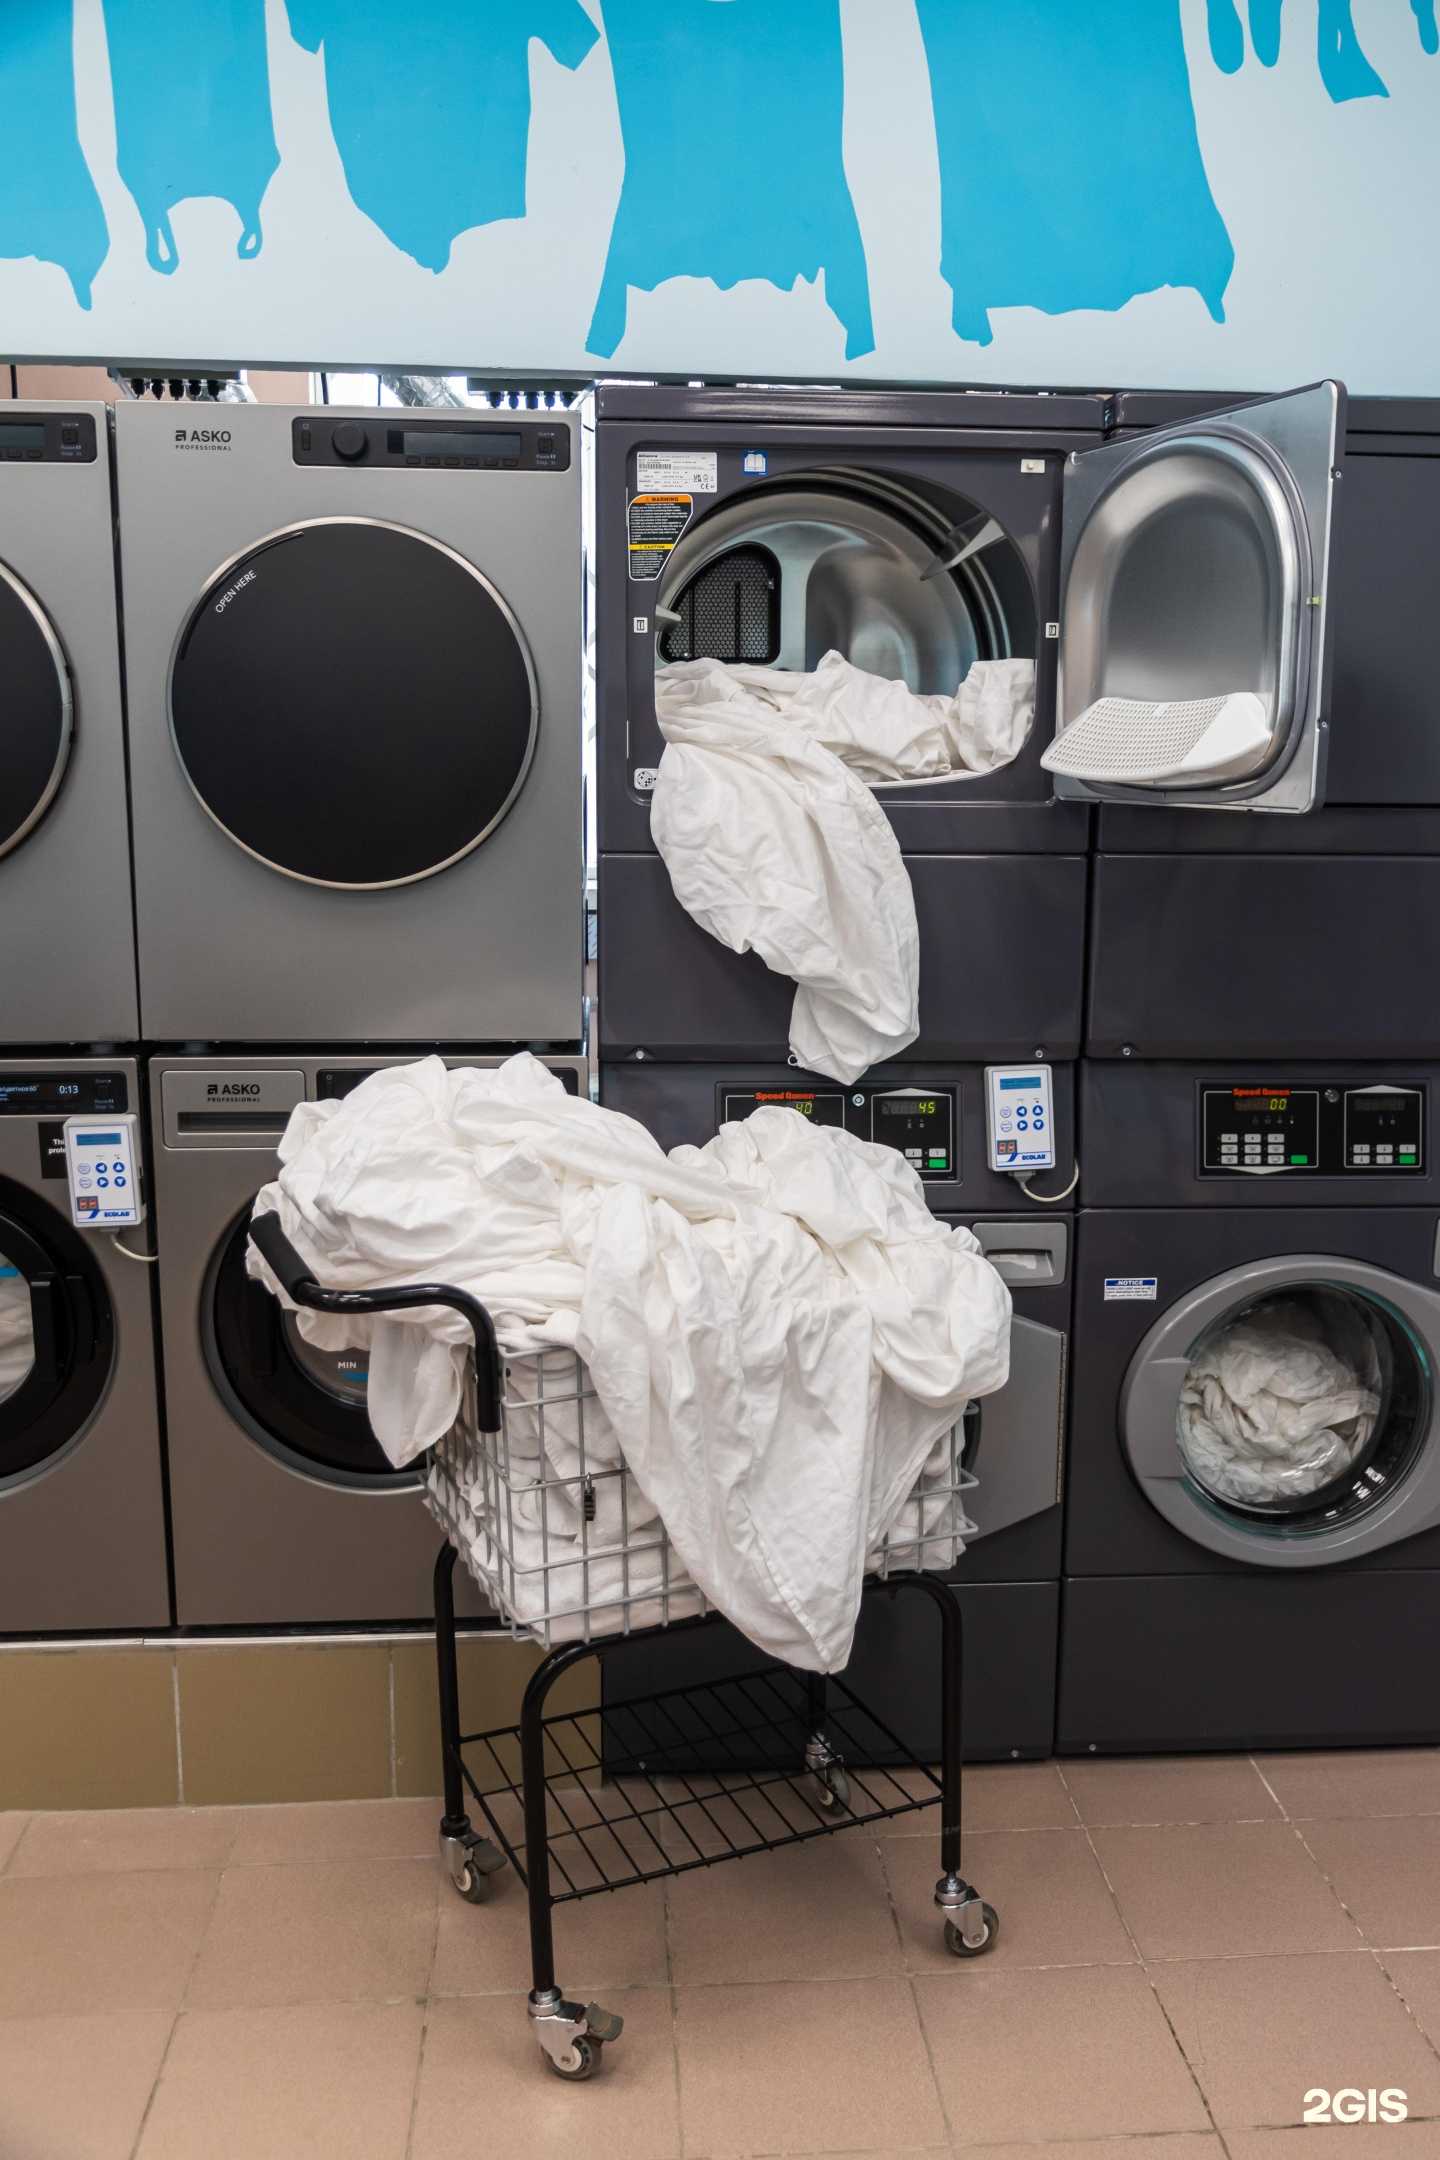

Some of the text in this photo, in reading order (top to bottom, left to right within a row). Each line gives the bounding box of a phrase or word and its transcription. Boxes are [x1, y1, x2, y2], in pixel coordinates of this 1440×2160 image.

[190, 430, 232, 443] ASKO
[215, 570, 257, 613] OPEN HERE
[58, 1085, 79, 1095] 0:13
[221, 1083, 261, 1095] ASKO
[919, 1101, 935, 1114] 45
[337, 1361, 357, 1369] MIN
